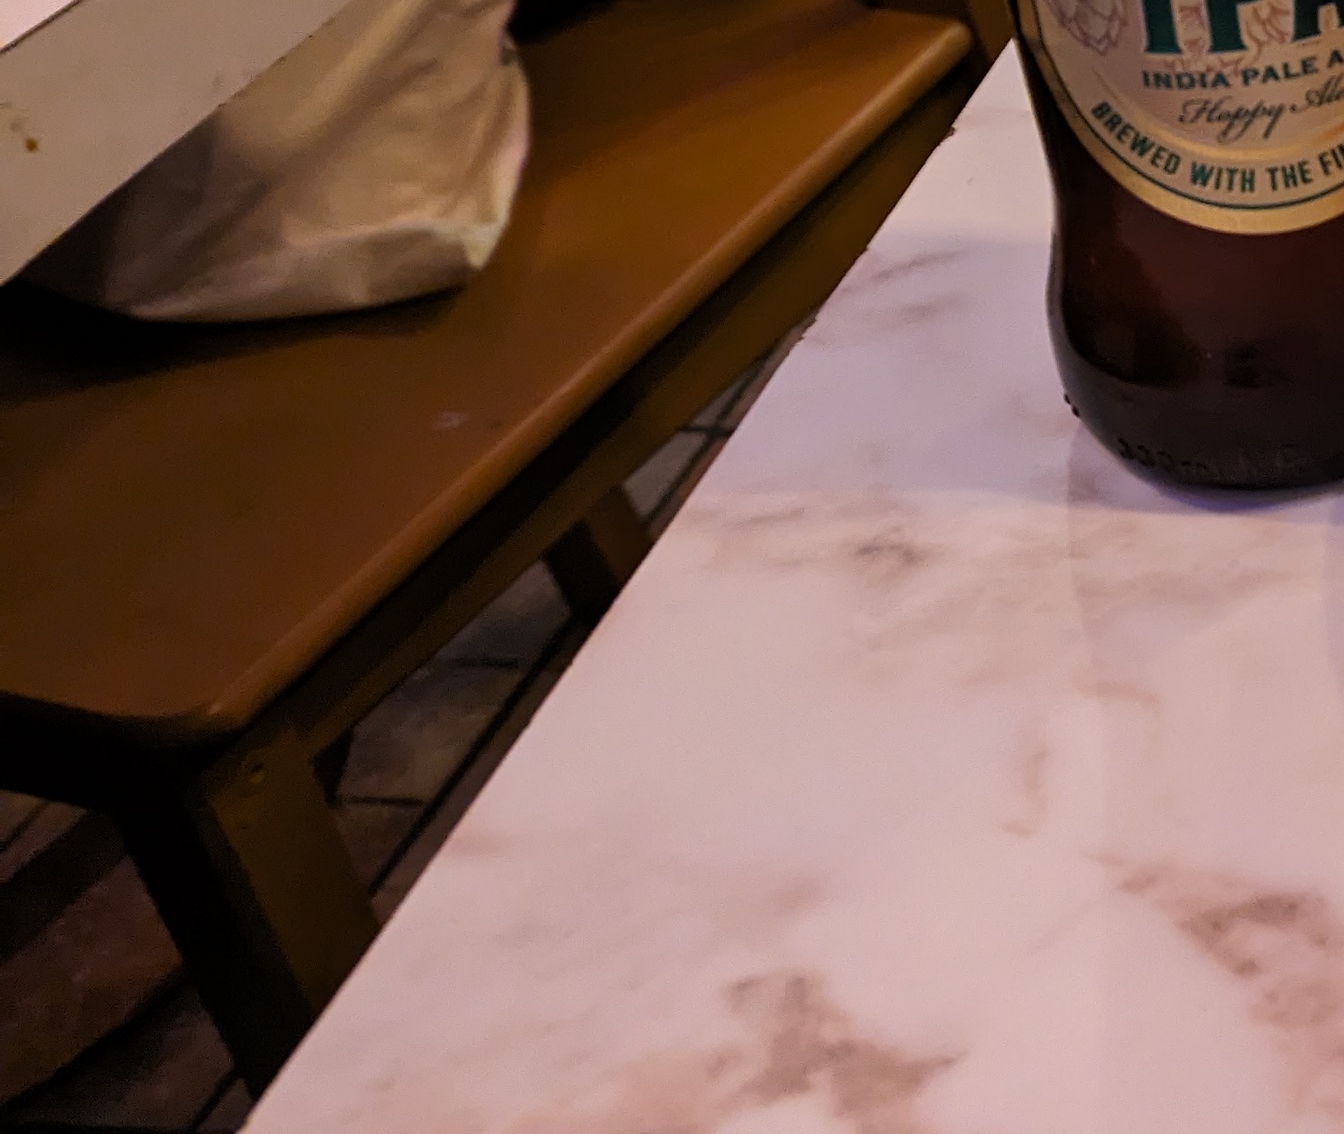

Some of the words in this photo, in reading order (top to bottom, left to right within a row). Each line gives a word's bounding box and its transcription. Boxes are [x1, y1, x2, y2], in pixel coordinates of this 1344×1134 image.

[1143, 70, 1229, 90] INDIA
[1241, 56, 1317, 88] PALE
[1179, 95, 1285, 144] Hoppy
[1090, 101, 1181, 177] BREWED
[1190, 163, 1256, 194] WITH
[1269, 161, 1312, 192] THE
